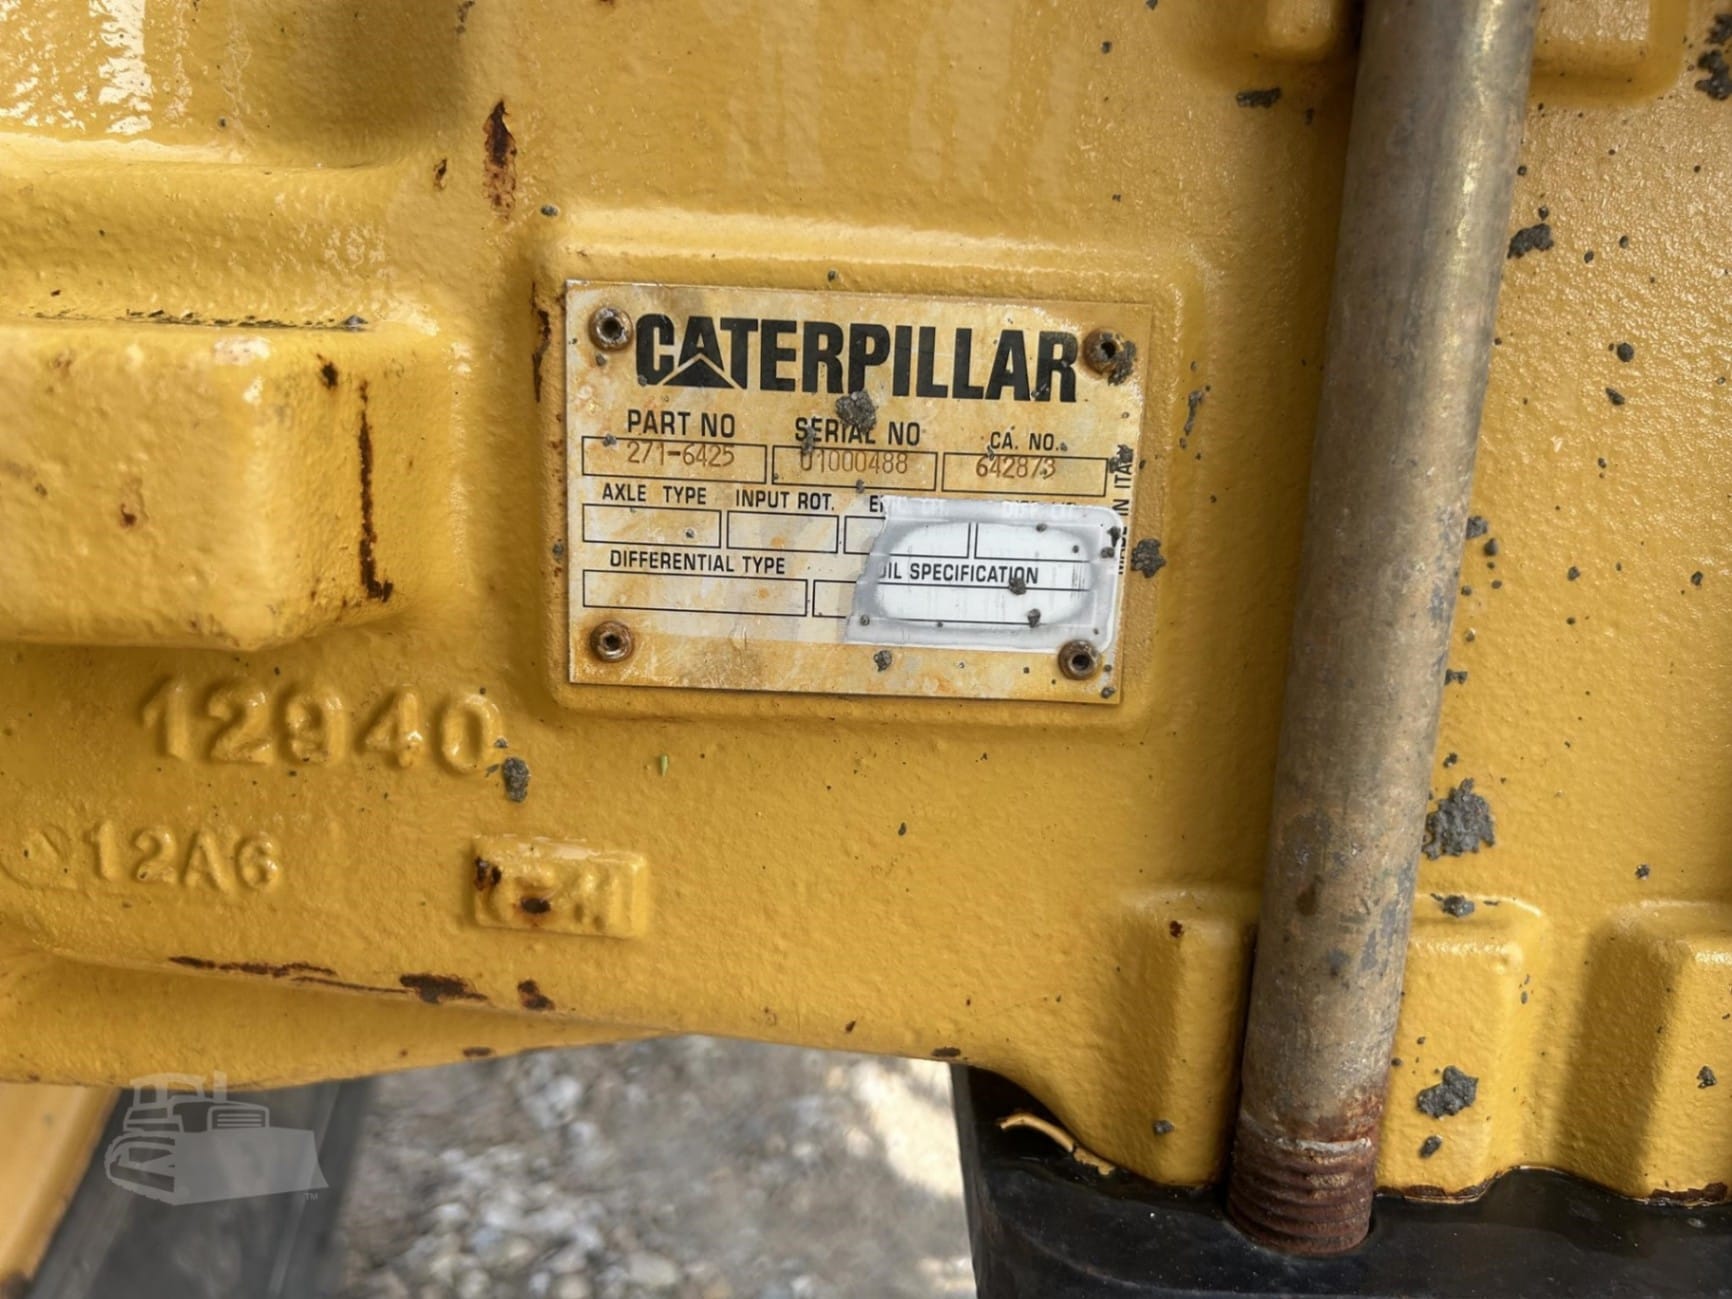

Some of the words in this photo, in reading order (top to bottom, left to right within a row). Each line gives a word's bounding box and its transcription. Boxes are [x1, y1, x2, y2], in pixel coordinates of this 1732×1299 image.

[635, 312, 1078, 404] CATERPILLAR
[627, 410, 691, 435] PART
[701, 412, 736, 439] NO
[795, 416, 876, 446] SERIAL
[887, 420, 921, 447] NO
[627, 441, 735, 468] 271-6425
[990, 431, 1019, 451] CA.
[1028, 432, 1062, 452] NO.
[602, 483, 647, 503] AXLE
[662, 486, 707, 506] TYPE
[735, 488, 791, 510] INPUT
[797, 490, 835, 512] ROT.
[609, 549, 735, 573] DIFFERENTIAL
[742, 554, 786, 576] TYPE
[909, 562, 1039, 585] SPECIFICATION
[139, 676, 504, 774] 12940
